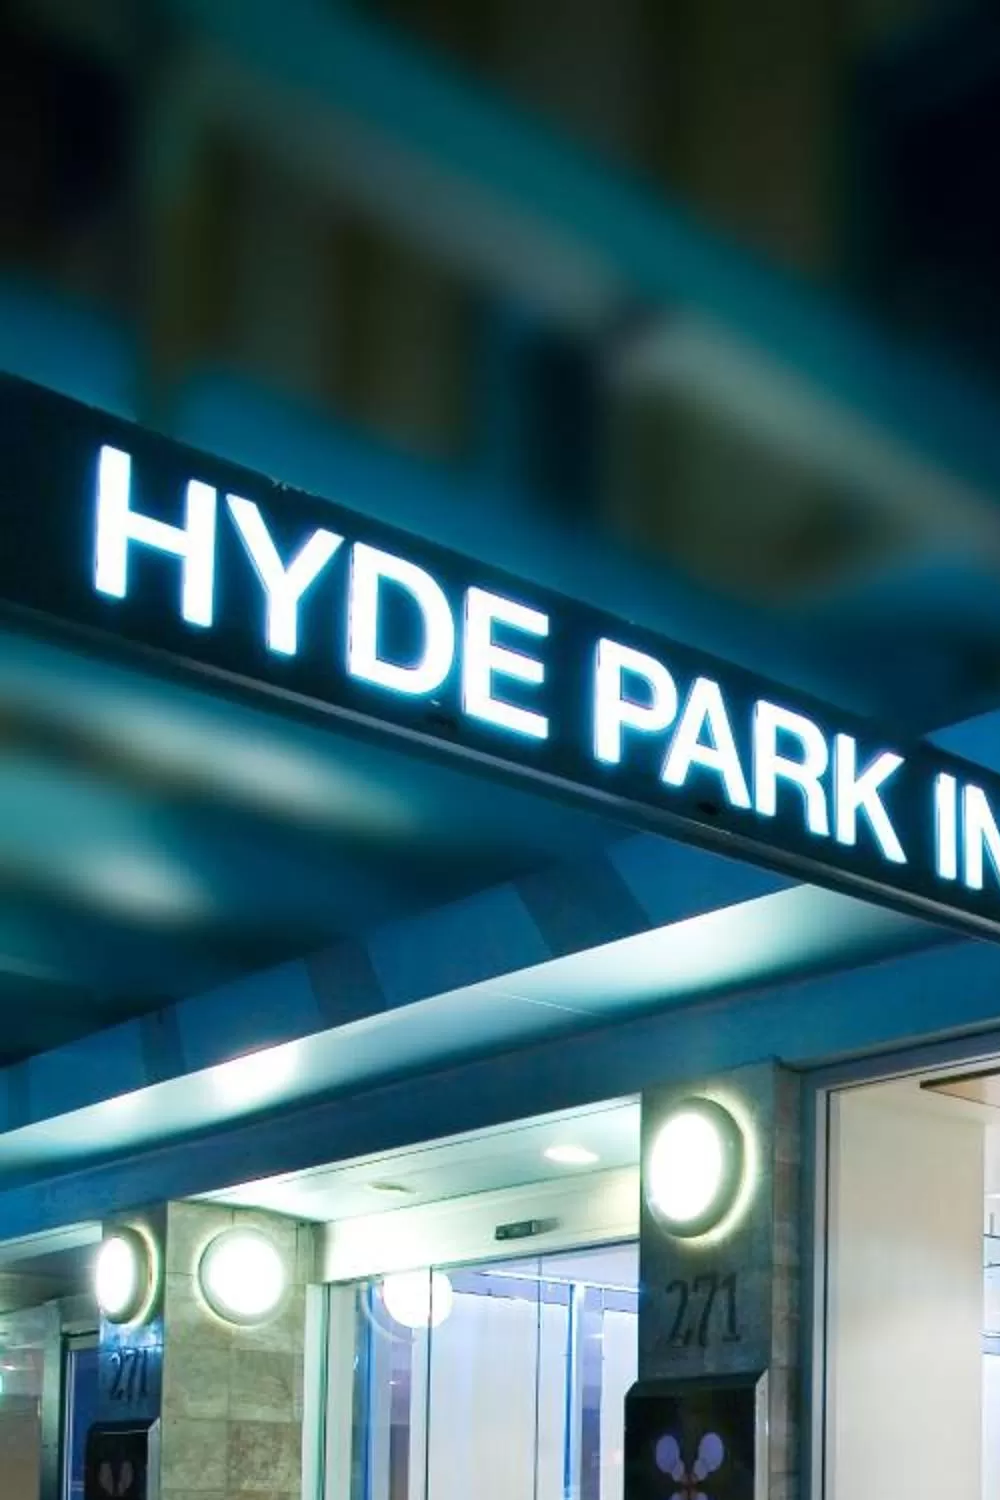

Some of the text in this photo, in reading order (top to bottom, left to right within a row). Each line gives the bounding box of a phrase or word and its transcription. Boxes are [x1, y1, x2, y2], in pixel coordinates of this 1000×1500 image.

[92, 442, 551, 741] HYDE
[594, 636, 908, 866] PARK
[664, 1271, 741, 1349] 271
